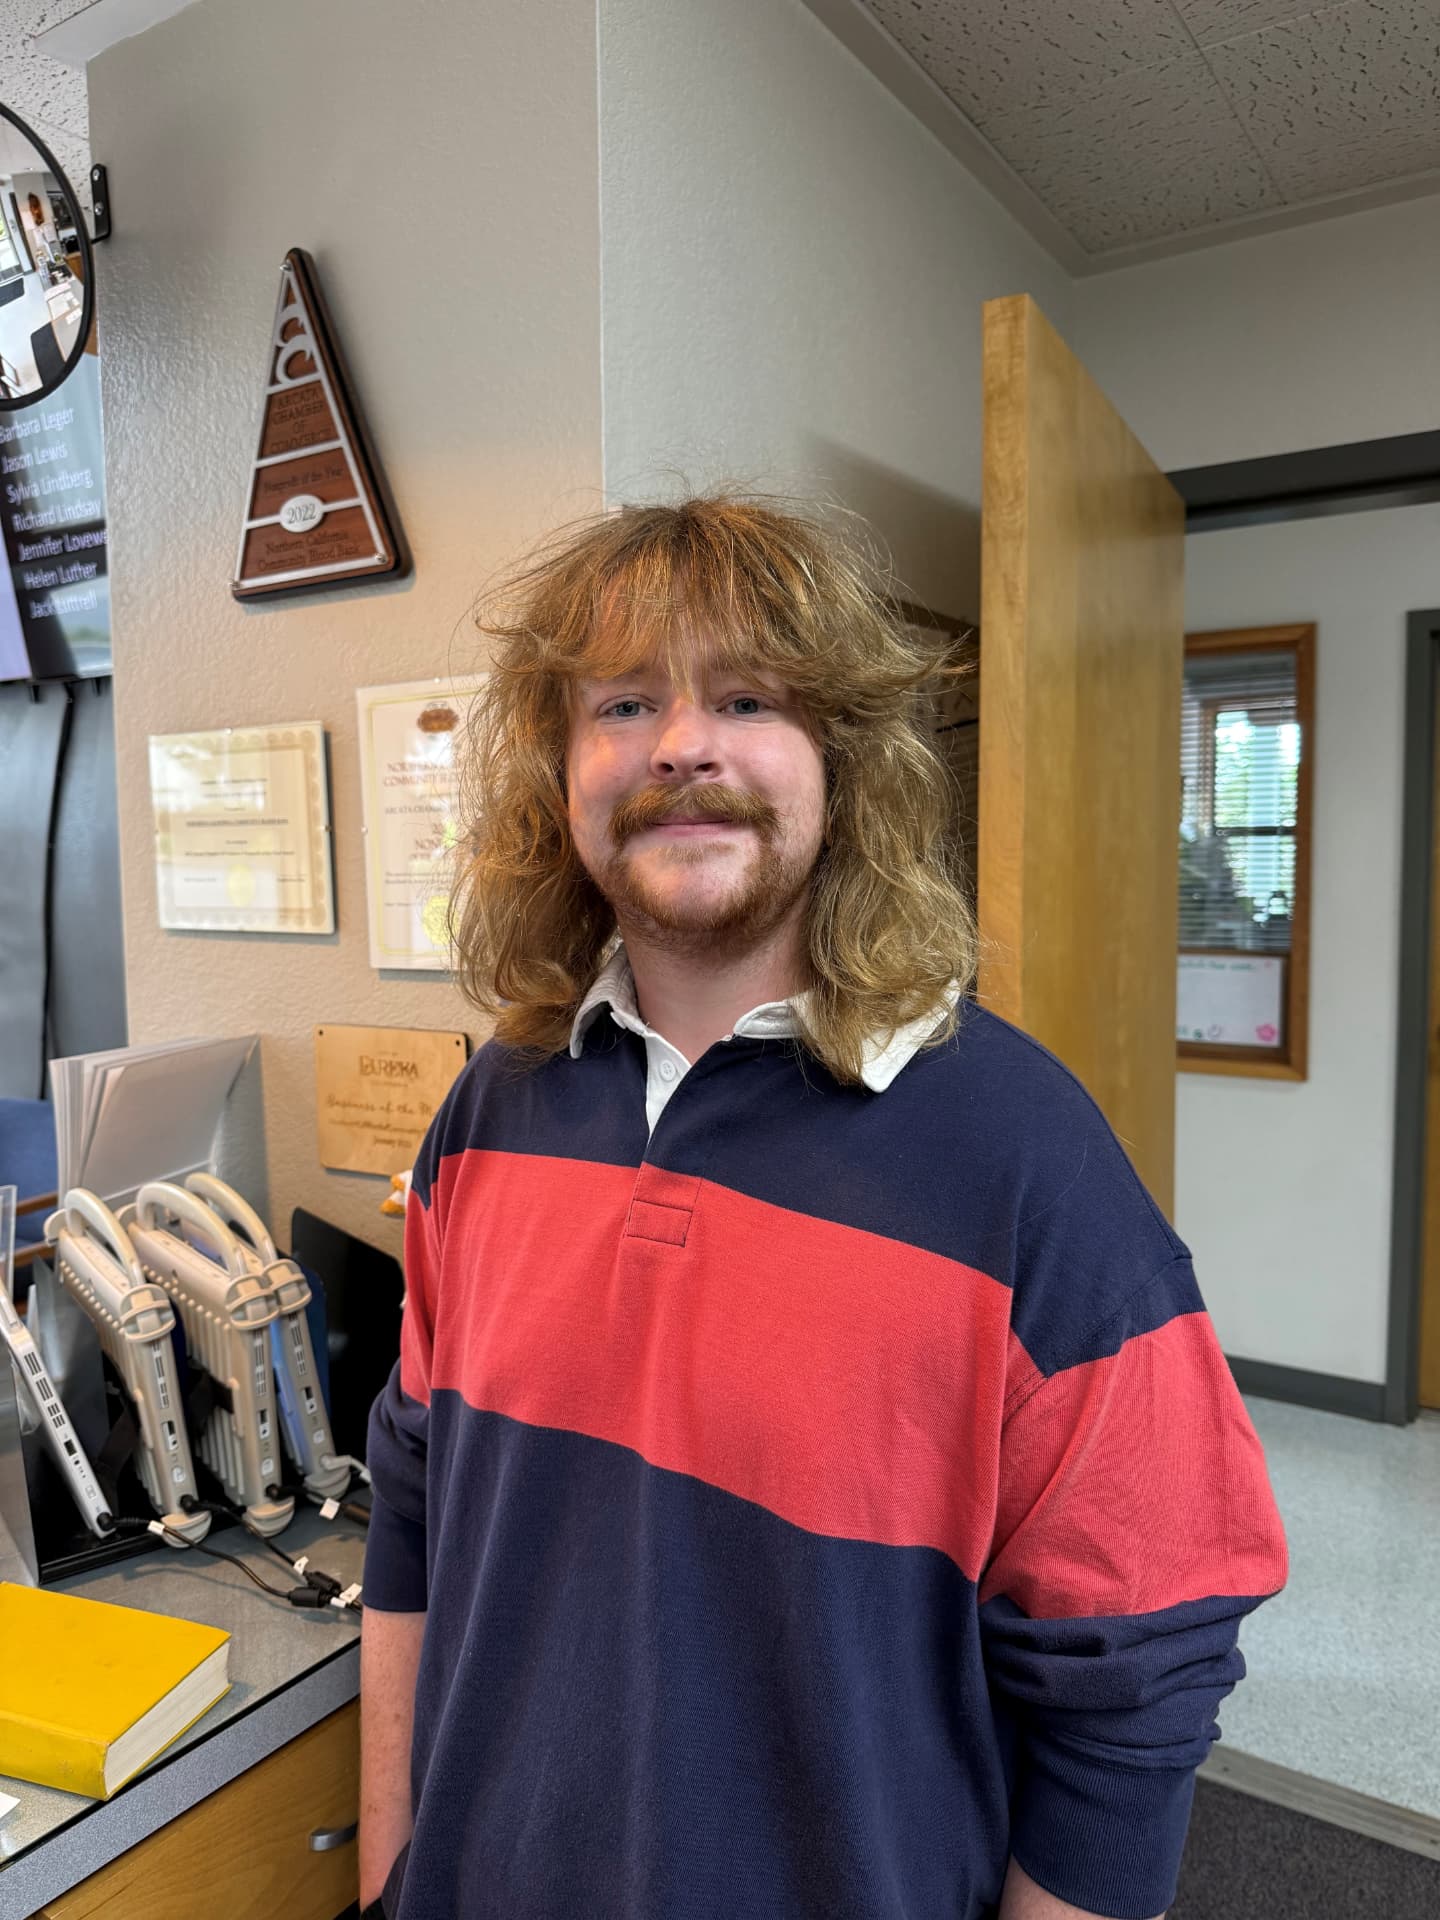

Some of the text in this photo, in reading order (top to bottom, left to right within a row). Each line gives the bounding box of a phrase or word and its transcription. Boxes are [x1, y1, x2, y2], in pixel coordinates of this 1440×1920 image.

[6, 480, 40, 505] Sylvia
[13, 508, 56, 533] Richard
[287, 503, 317, 524] 2022
[19, 537, 63, 561] Jennifer
[24, 562, 97, 590] Helen Luther
